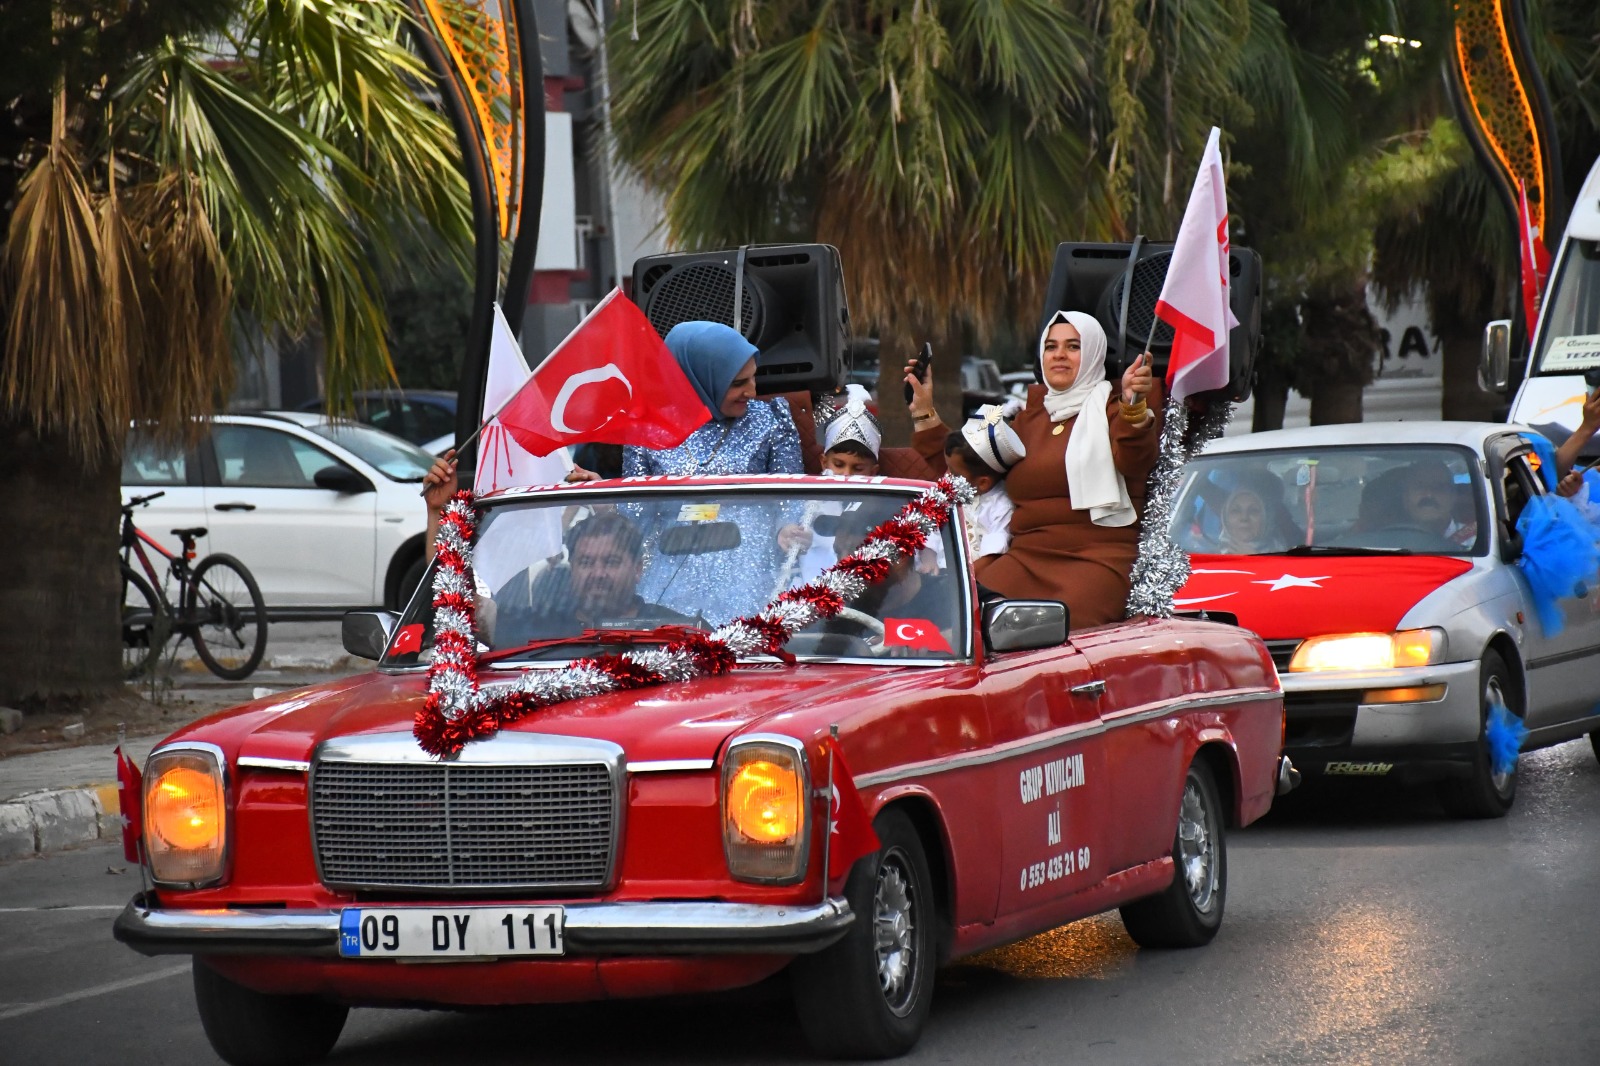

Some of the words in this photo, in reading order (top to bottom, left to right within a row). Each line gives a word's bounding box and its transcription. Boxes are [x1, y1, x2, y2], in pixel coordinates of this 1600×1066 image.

[1020, 766, 1043, 804] GRUP
[1044, 753, 1085, 796] KIVILCIM
[1048, 801, 1061, 846] ALİ
[1020, 868, 1027, 891] 0
[1028, 861, 1045, 889] 553
[1047, 855, 1063, 881] 435
[1065, 851, 1075, 875] 21
[1078, 846, 1090, 871] 60
[345, 936, 358, 947] TR
[361, 914, 400, 951] 09
[432, 914, 471, 951] DY
[501, 913, 557, 950] 111
